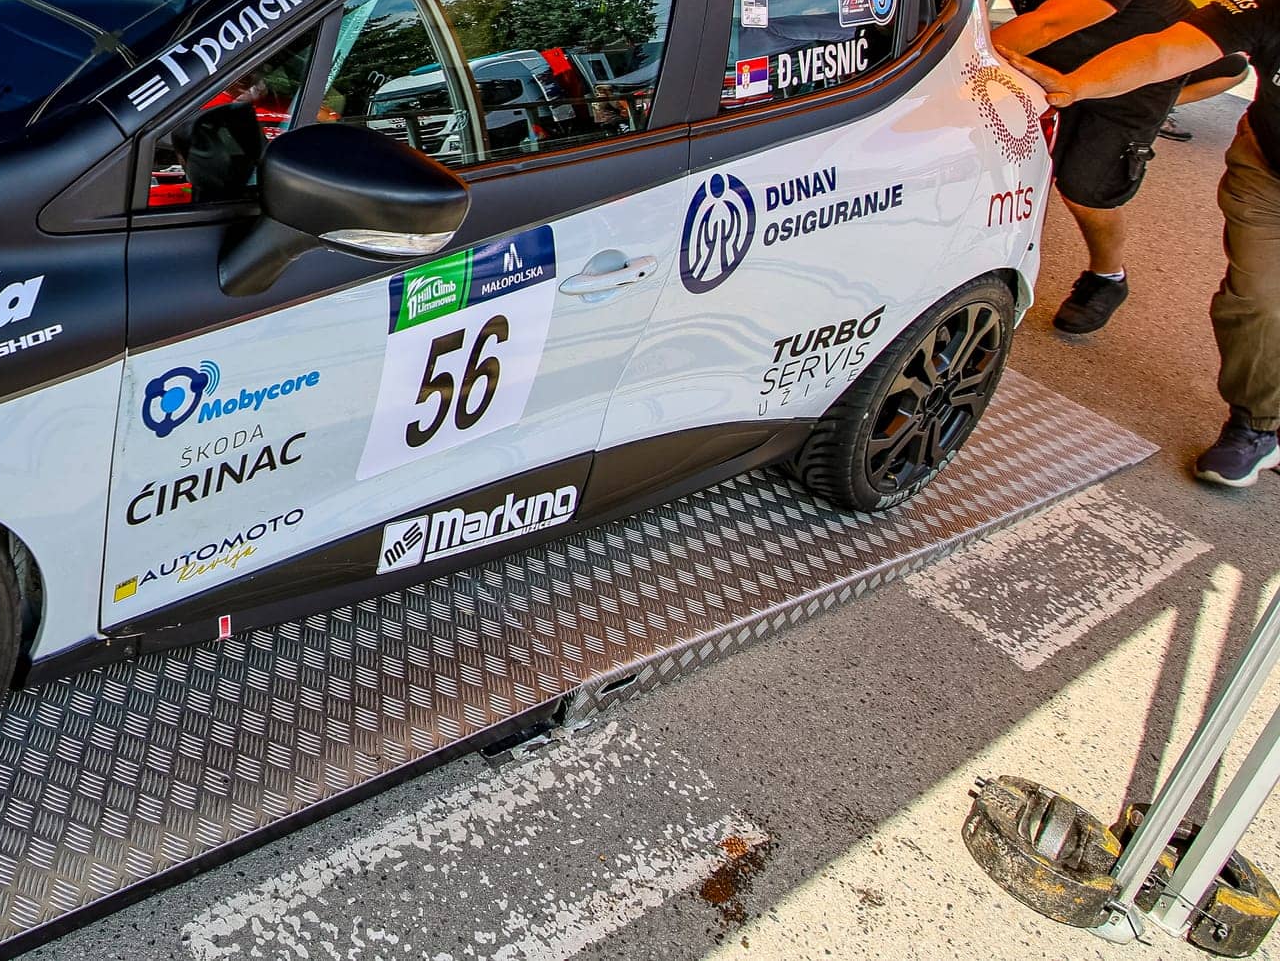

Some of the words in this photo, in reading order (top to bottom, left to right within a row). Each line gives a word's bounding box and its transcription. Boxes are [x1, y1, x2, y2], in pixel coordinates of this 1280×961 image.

[777, 29, 869, 89] Đ.VESNIĆ
[763, 182, 904, 247] OSIGURANJE
[765, 166, 837, 212] DUNAV
[987, 180, 1034, 228] mts
[418, 285, 432, 303] Hill
[433, 279, 456, 297] Climb
[418, 294, 456, 313] Limanowa
[481, 265, 544, 295] MAŁOPOLSKA
[772, 304, 887, 364] TURBO
[404, 314, 510, 450] 56
[759, 341, 872, 396] SERVIS
[197, 370, 321, 424] Mobycore
[180, 423, 265, 469] ŠKODA
[125, 431, 307, 526] ĆIRINAC
[138, 508, 304, 587] AUTOMOTO
